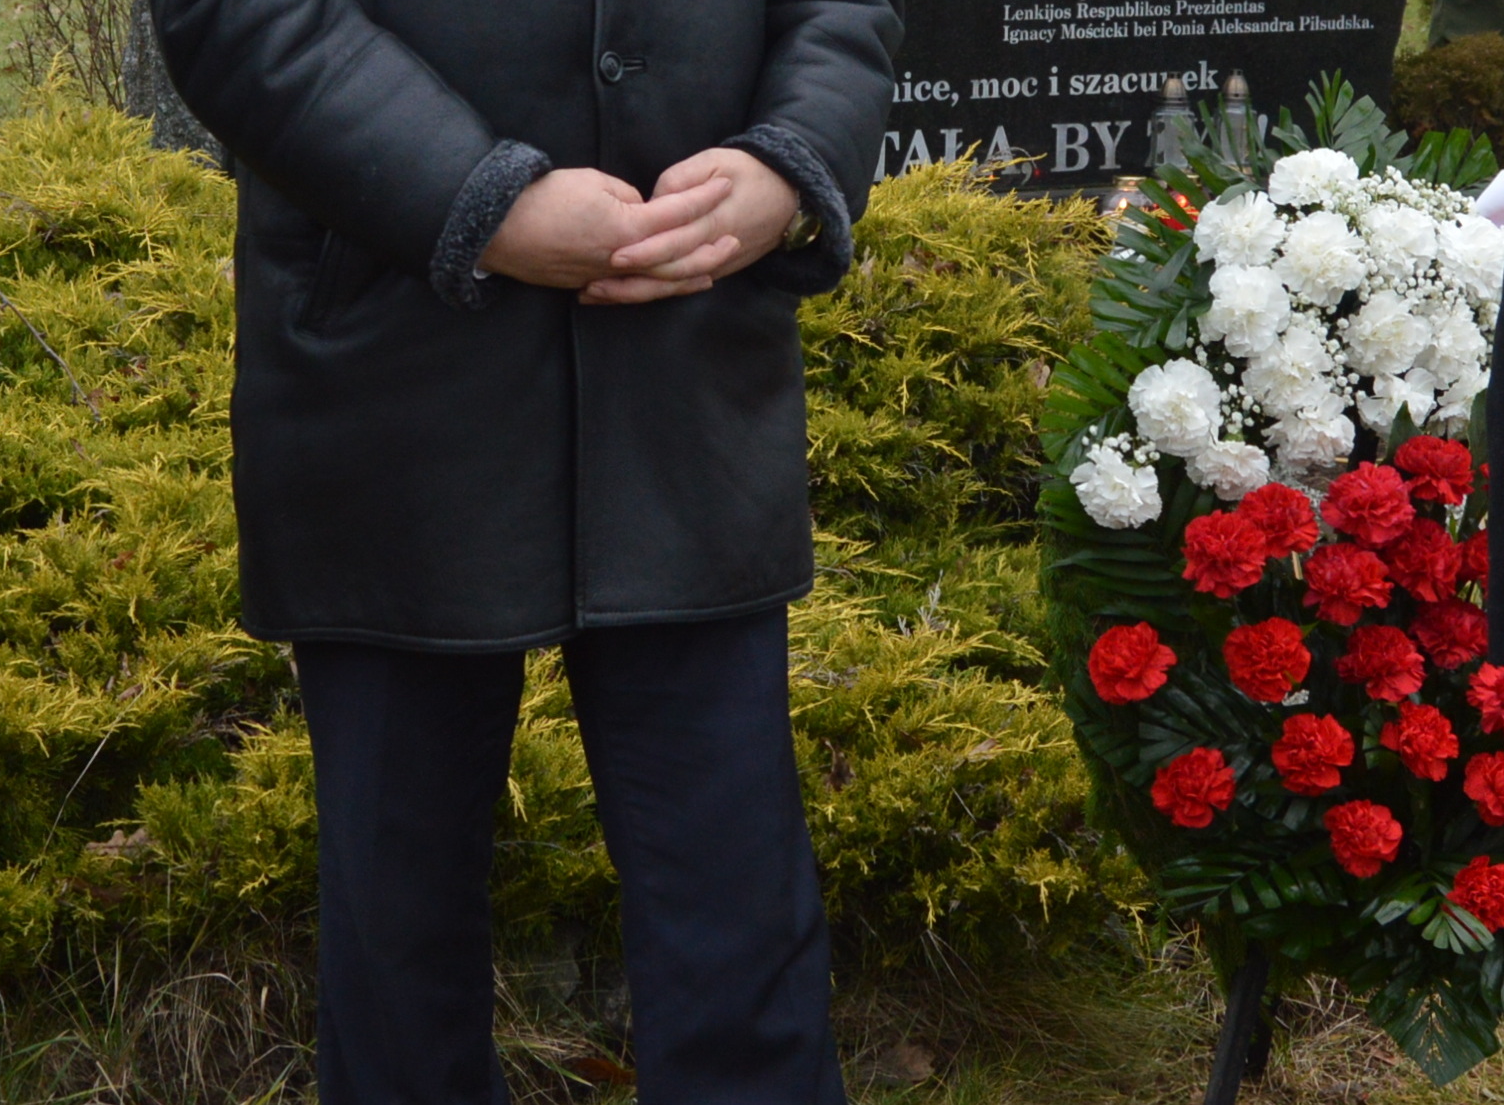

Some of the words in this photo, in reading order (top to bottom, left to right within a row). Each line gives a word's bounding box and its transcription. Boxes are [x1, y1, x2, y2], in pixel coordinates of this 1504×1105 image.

[1004, 4, 1071, 22] Lenkijos
[1077, 1, 1171, 20] Respublikos
[1176, 0, 1265, 16] Prezidentas
[1003, 25, 1056, 44] Ignacy
[1061, 22, 1128, 40] Mościcki
[1134, 21, 1156, 36] bei
[1162, 20, 1205, 36] Ponia
[1210, 17, 1294, 34] Aleksandra
[1299, 15, 1374, 31] Piłsudska.
[970, 76, 1038, 99] moc
[1048, 66, 1060, 96] i
[1069, 60, 1218, 95] szacuek
[1051, 121, 1132, 172] BY
